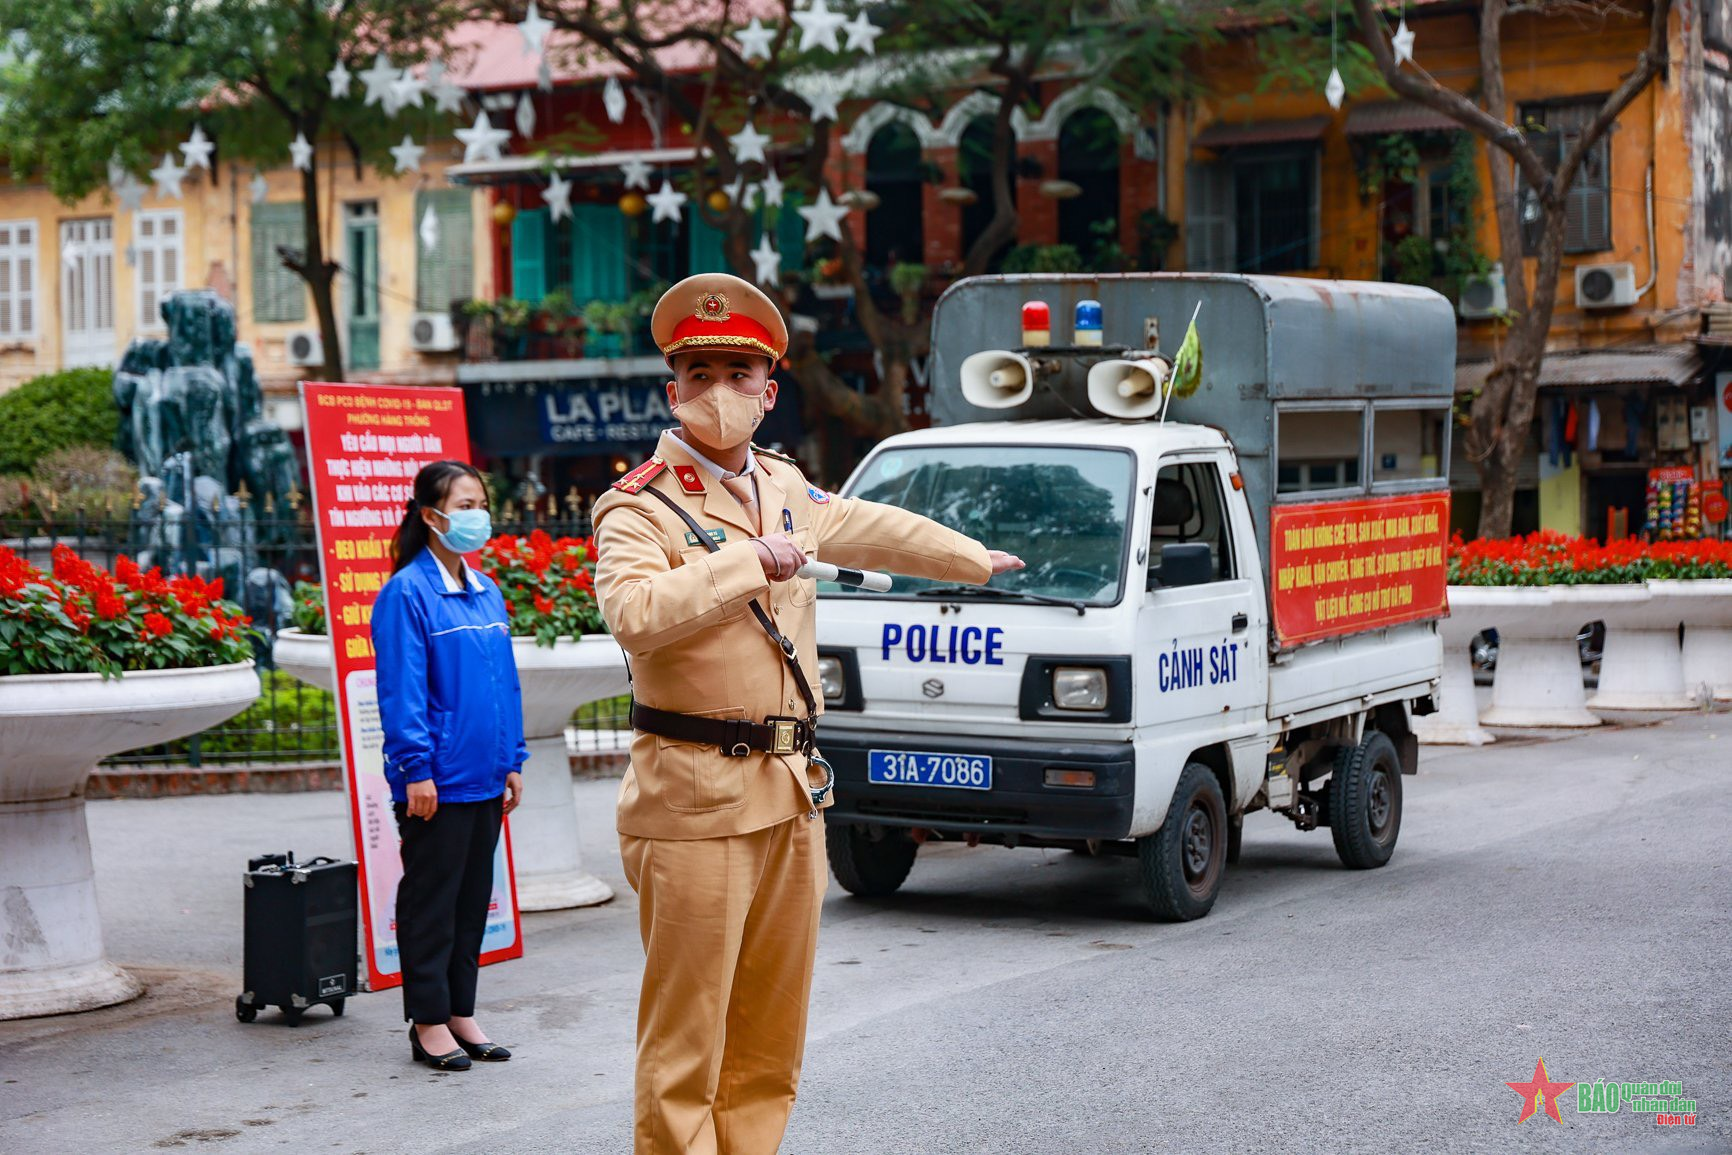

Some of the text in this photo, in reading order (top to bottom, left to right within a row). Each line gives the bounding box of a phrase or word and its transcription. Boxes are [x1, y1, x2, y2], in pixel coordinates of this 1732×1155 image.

[347, 412, 380, 426] PHƯỜNG
[545, 387, 671, 423] LA PLA
[340, 431, 359, 452] YÊU
[359, 429, 378, 452] CẦU
[396, 432, 424, 453] NGƯỜI
[423, 433, 443, 453] DÂN
[550, 424, 597, 442] CAFE
[326, 459, 351, 480] THỰC
[351, 456, 373, 481] HIỆN
[373, 457, 404, 477] NHỮNG
[353, 482, 372, 502] VÀO
[371, 482, 390, 502] CÁC
[390, 484, 404, 502] CƠ
[345, 506, 383, 527] NGƯỠNG
[1284, 524, 1301, 552] TOÀN
[1301, 523, 1314, 550] DÂN
[1314, 521, 1333, 548] KHÔNG
[1333, 517, 1346, 546] CHẾ
[1358, 515, 1371, 543] SẢN
[1386, 518, 1398, 539] MUA
[1411, 508, 1425, 536] XUẤT
[355, 532, 382, 559] KHẨU
[339, 566, 354, 593] SỬ
[354, 571, 382, 596] DỤNG
[1278, 563, 1295, 594] NHẬP
[1314, 559, 1326, 589] VẬN
[1350, 554, 1365, 579] TÀNG
[1386, 552, 1400, 578] DỤNG
[1400, 547, 1412, 572] TRÁI
[1412, 544, 1425, 569] PHÉP
[1315, 595, 1326, 625] VẬT
[1326, 593, 1338, 624] LIỆU
[1349, 590, 1364, 615] CÔNG
[1398, 580, 1412, 605] PHÁO
[882, 623, 1005, 666] POLICE
[1159, 637, 1238, 693] CẢNH SÁT
[883, 754, 985, 786] 31A-7086
